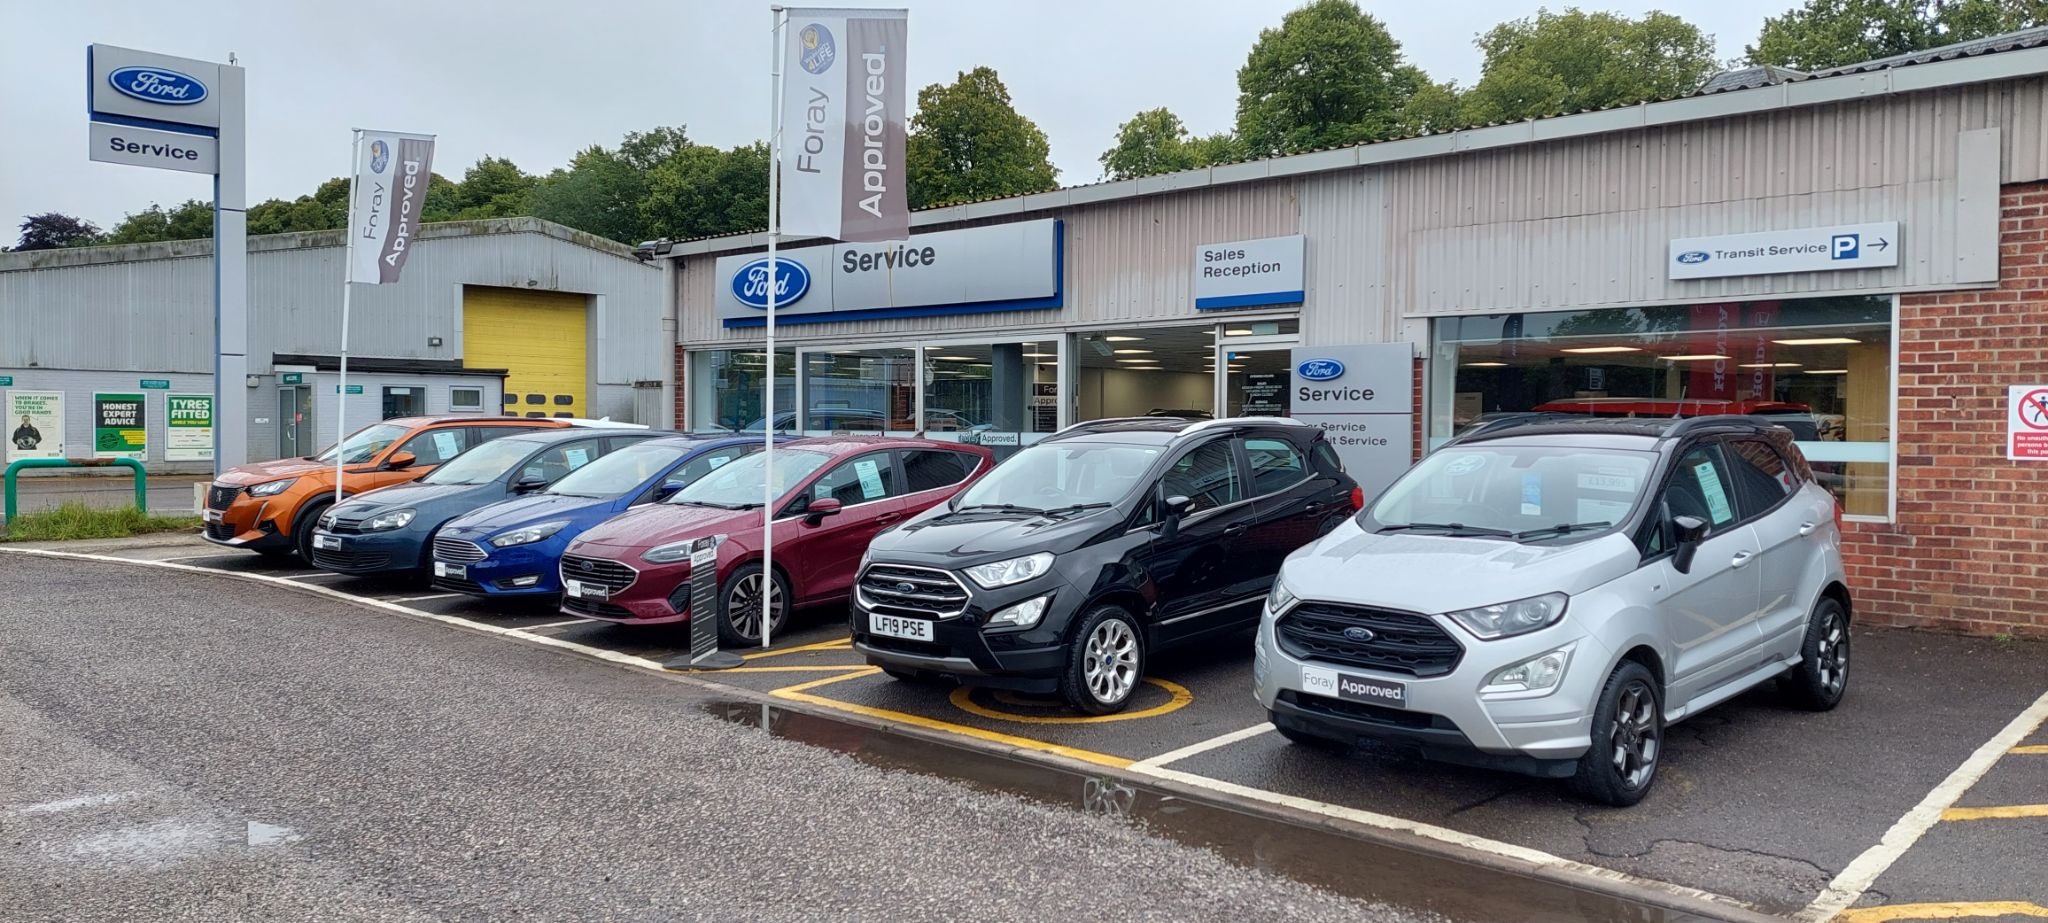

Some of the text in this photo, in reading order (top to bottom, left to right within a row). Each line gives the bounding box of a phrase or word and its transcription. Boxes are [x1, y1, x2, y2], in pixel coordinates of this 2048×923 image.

[131, 71, 190, 99] Ford
[796, 86, 829, 174] Foray
[110, 136, 199, 161] Service
[363, 181, 385, 240] Foray
[1204, 249, 1245, 263] Sales
[1715, 247, 1765, 260] Transit
[1768, 243, 1828, 256] Service
[1834, 237, 1856, 258] P
[842, 244, 936, 274] Service
[1203, 261, 1281, 279] Reception
[743, 266, 789, 297] Fod
[1305, 361, 1334, 376] Ford
[1299, 386, 1374, 401] Service
[171, 399, 210, 409] TYRES
[171, 409, 210, 419] FITTED
[1321, 422, 1366, 432] Service
[1339, 436, 1388, 446] Service
[875, 616, 925, 637] LF19 PSE
[1303, 672, 1335, 689] Foray
